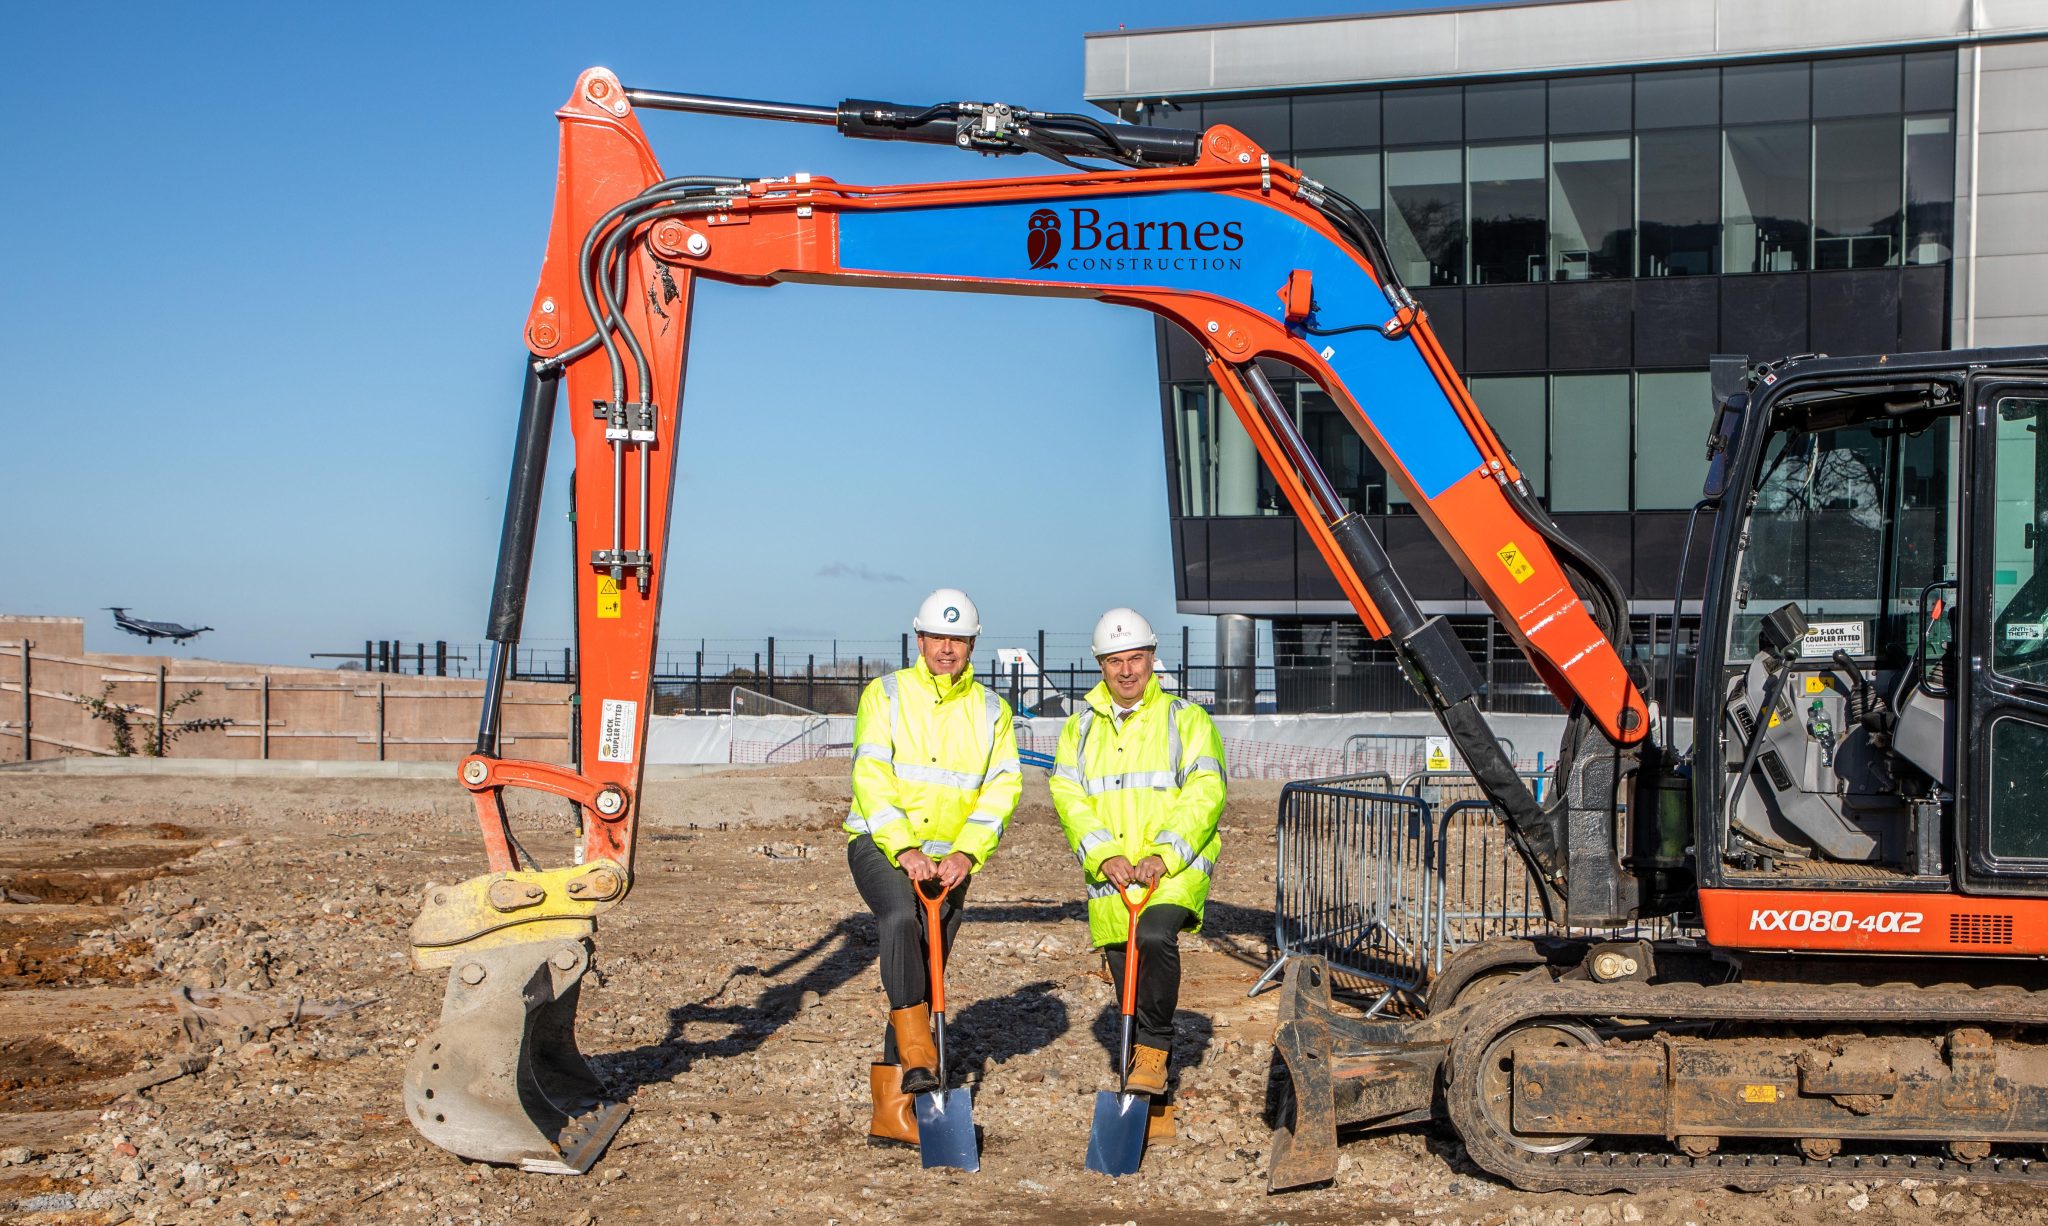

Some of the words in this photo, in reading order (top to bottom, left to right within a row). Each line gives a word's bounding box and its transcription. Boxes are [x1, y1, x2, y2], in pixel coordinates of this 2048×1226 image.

[1069, 208, 1244, 251] Barnes
[1068, 258, 1241, 270] CONSTRUCTION
[1805, 635, 1836, 643] COUPLER
[1837, 634, 1860, 642] FITTED
[612, 728, 621, 758] COUPLER
